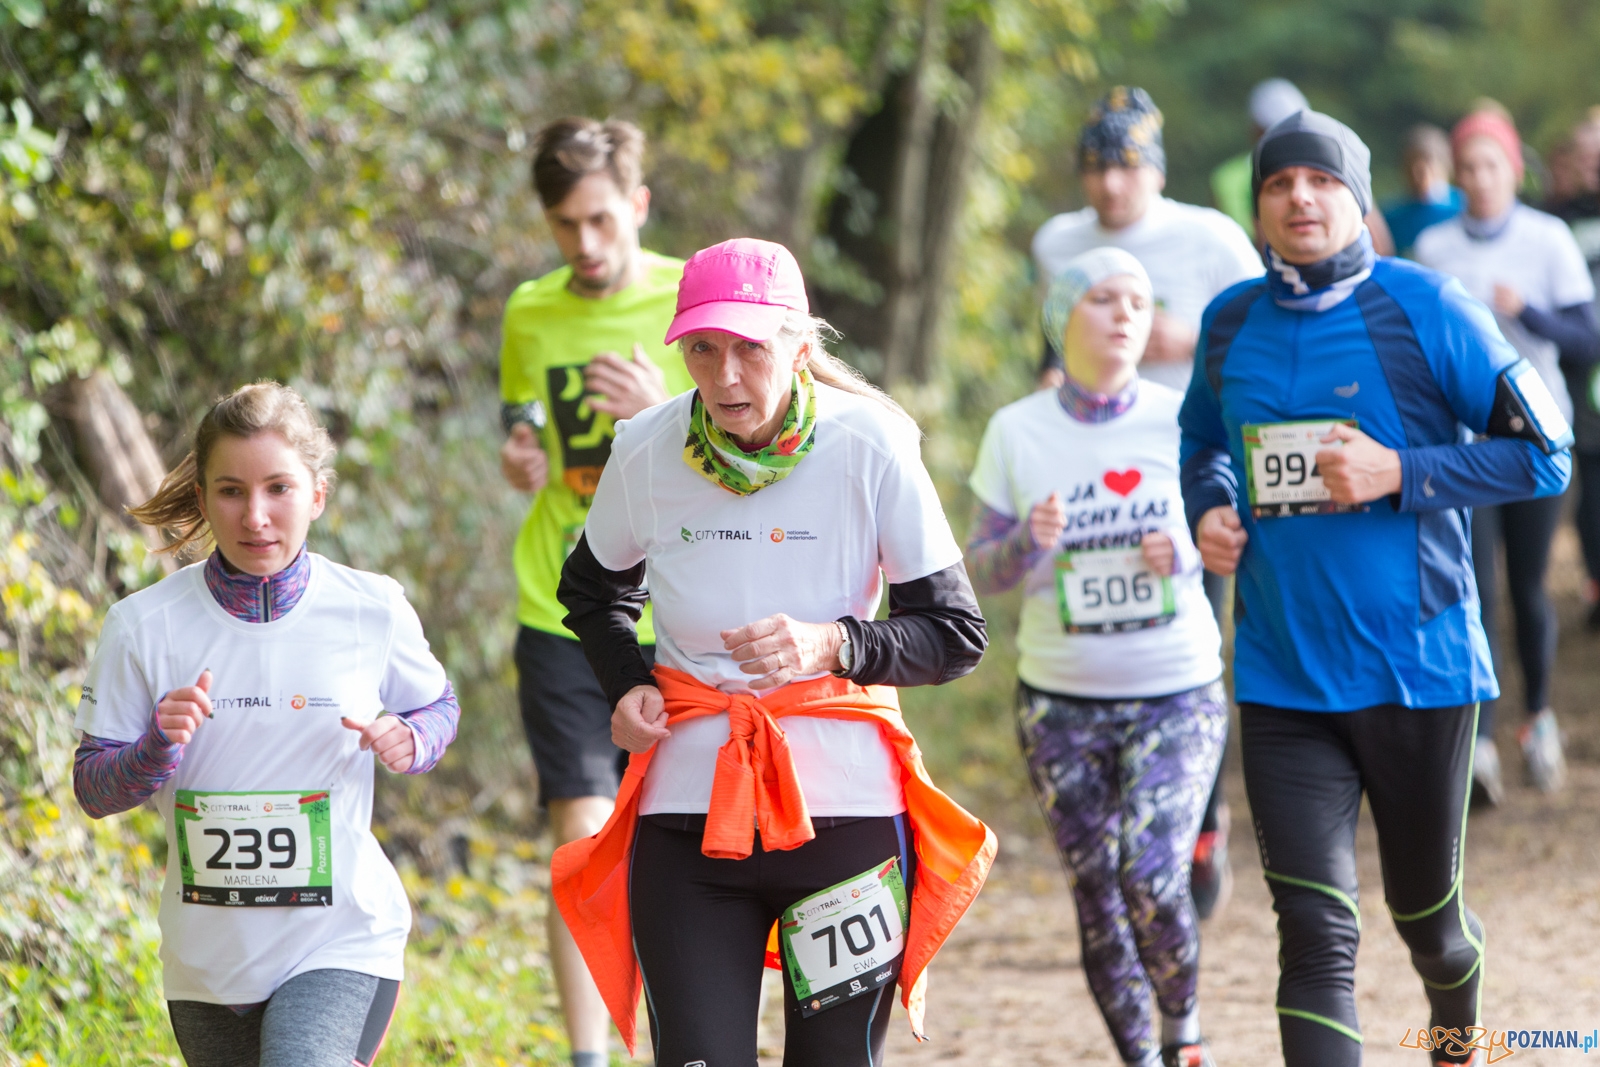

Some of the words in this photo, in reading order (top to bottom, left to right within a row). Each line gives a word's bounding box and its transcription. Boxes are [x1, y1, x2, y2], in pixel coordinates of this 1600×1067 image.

[1067, 482, 1096, 503] JA
[1130, 498, 1169, 521] LAS
[1082, 571, 1153, 609] 506
[203, 827, 297, 870] 239
[317, 836, 327, 874] Poznań
[224, 875, 278, 886] MARLENA
[811, 904, 892, 968] 701
[853, 957, 878, 974] EWA
